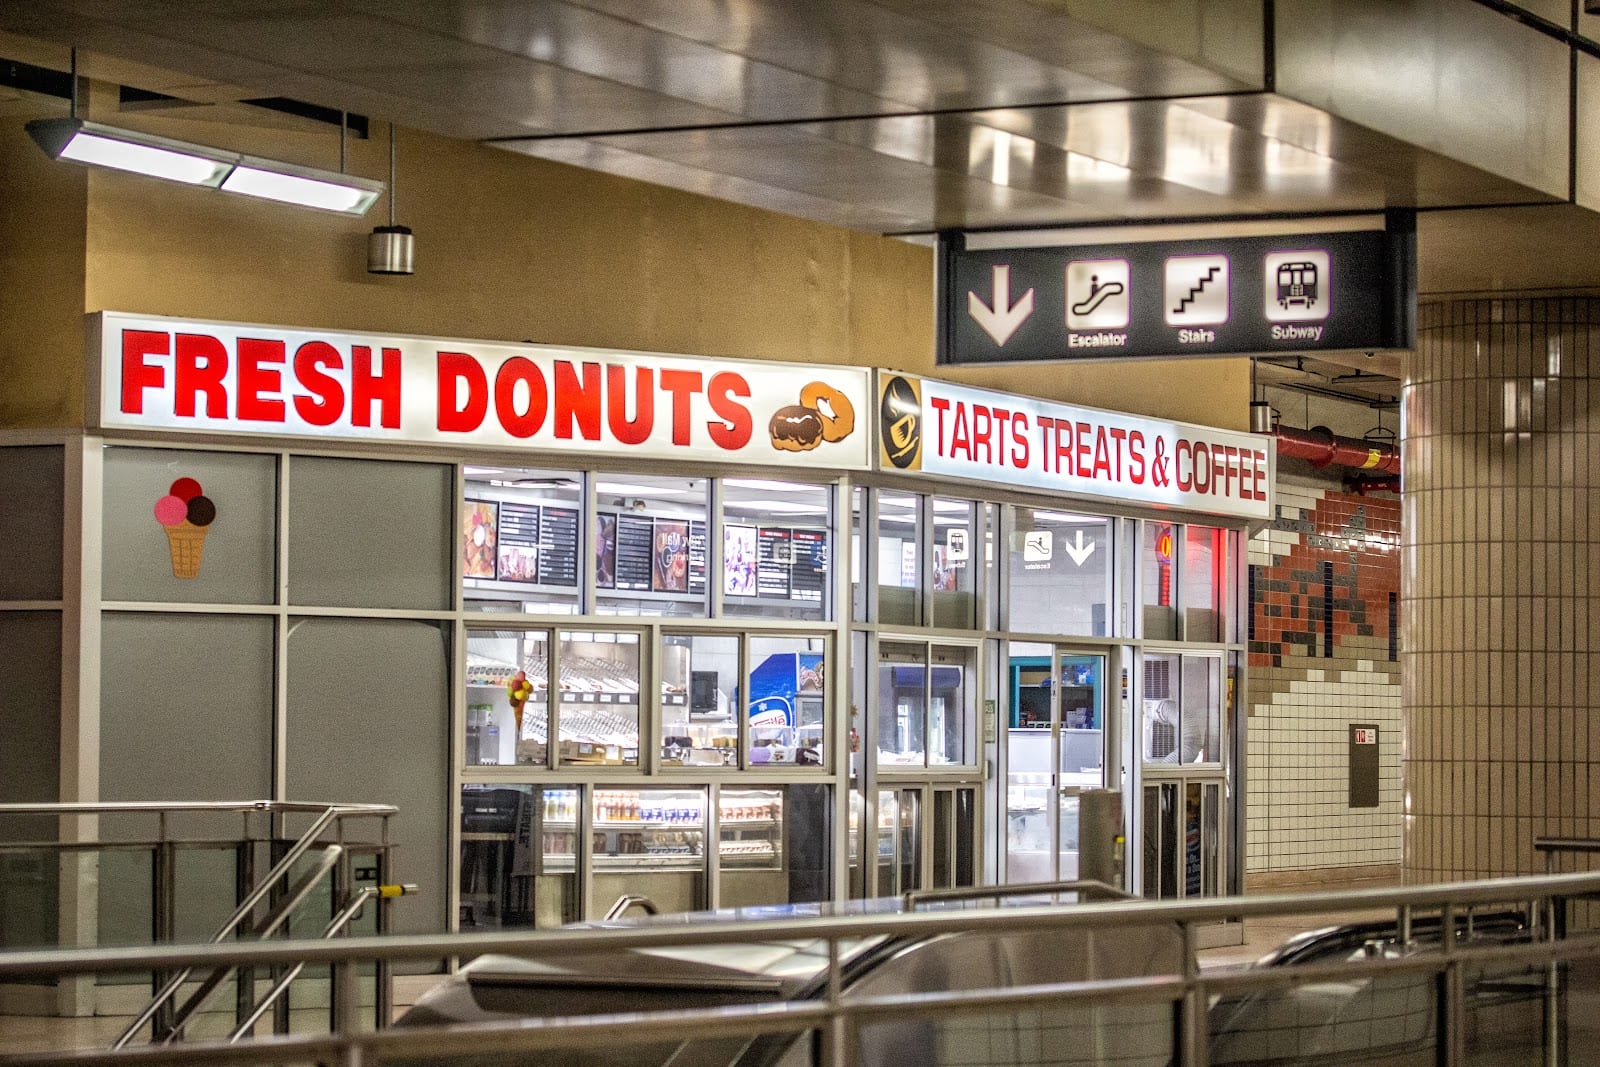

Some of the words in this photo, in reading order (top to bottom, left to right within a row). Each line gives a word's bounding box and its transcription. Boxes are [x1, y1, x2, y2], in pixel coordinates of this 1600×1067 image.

[1067, 332, 1127, 347] Escalator
[1178, 328, 1215, 344] Stairs
[1271, 324, 1324, 342] Subway
[119, 328, 402, 430] FRESH
[436, 351, 753, 450] DONUTS
[930, 397, 1029, 469] TARTS
[1036, 415, 1146, 485] TREATS
[1151, 434, 1171, 488] &
[1174, 438, 1267, 502] COFFEE
